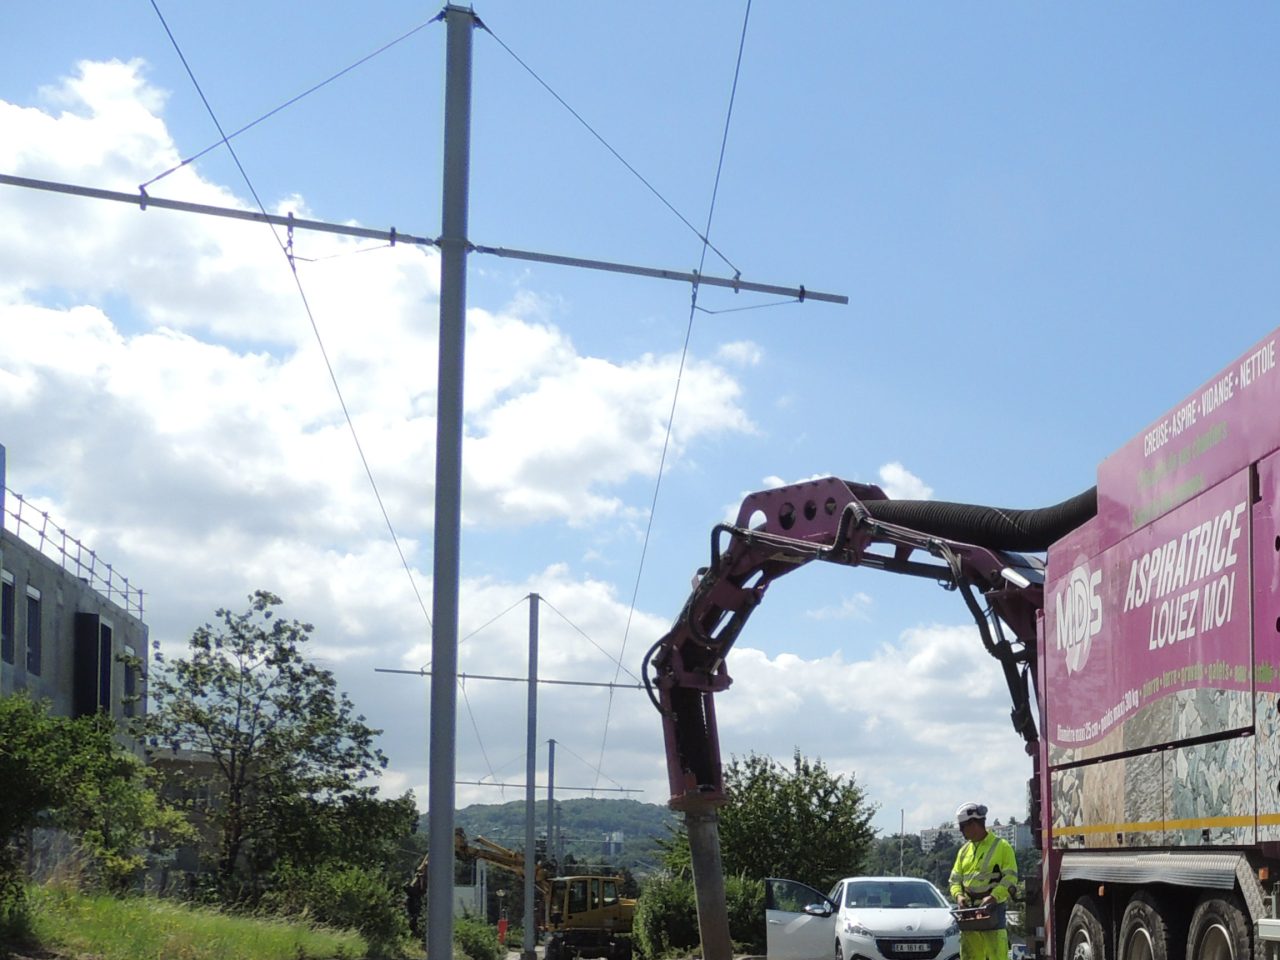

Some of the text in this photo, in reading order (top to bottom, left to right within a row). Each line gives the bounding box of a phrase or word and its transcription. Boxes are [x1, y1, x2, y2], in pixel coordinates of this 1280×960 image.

[1143, 419, 1169, 458] CREUSE
[1171, 399, 1197, 439] ASPIRE
[1201, 371, 1234, 417] VIDANGE
[1239, 339, 1276, 390] NETTOIE
[1123, 500, 1247, 613] ASPIRATRICE
[1056, 568, 1103, 651] MDS
[1148, 571, 1236, 651] LOUEZ MOI
